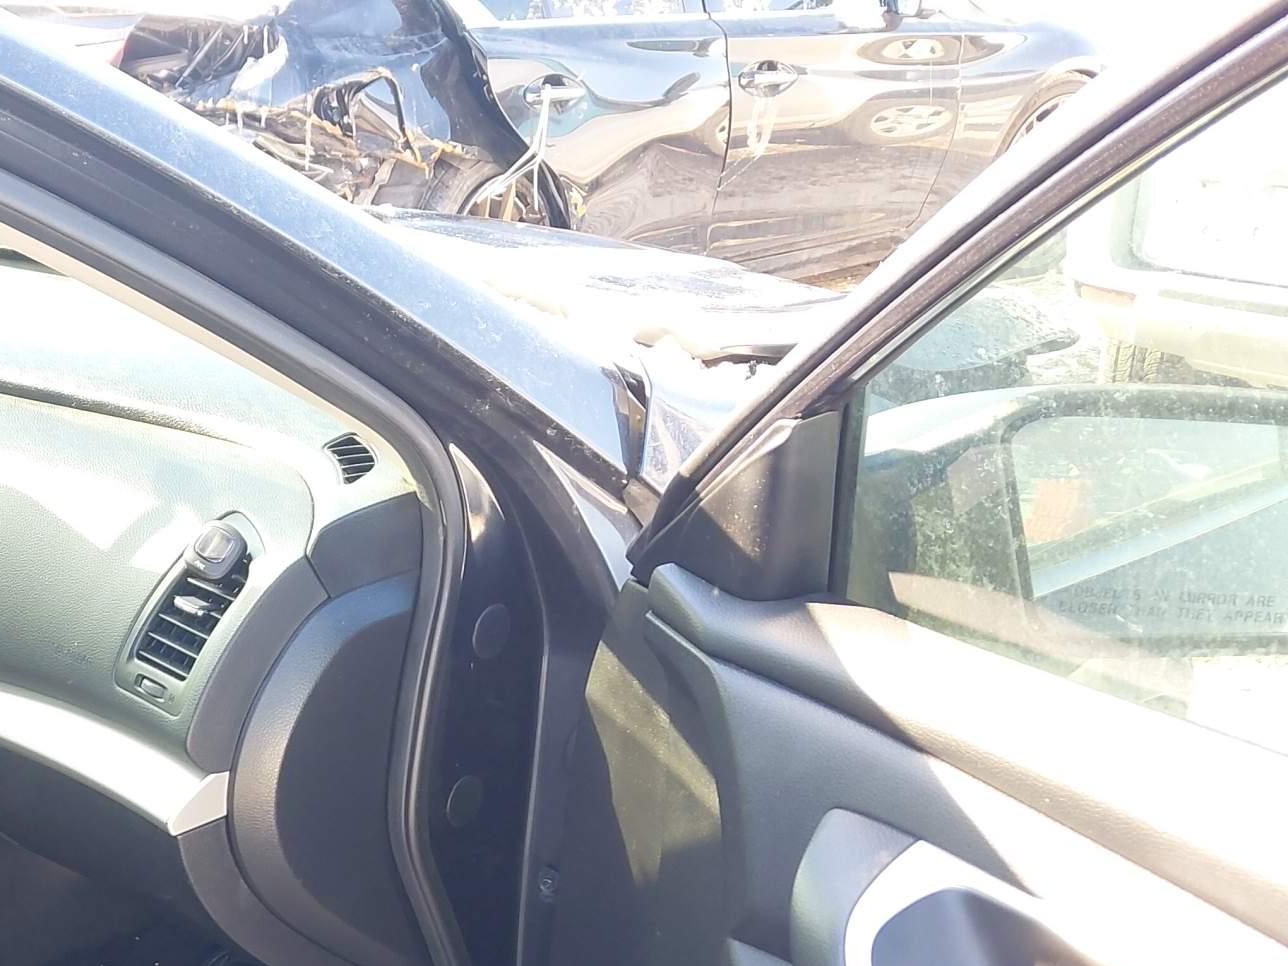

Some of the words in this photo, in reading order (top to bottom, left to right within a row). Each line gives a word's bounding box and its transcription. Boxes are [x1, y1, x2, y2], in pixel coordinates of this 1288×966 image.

[1246, 594, 1276, 609] ARE
[1058, 600, 1117, 616] CLOSER
[1223, 609, 1285, 625] APPEAR
